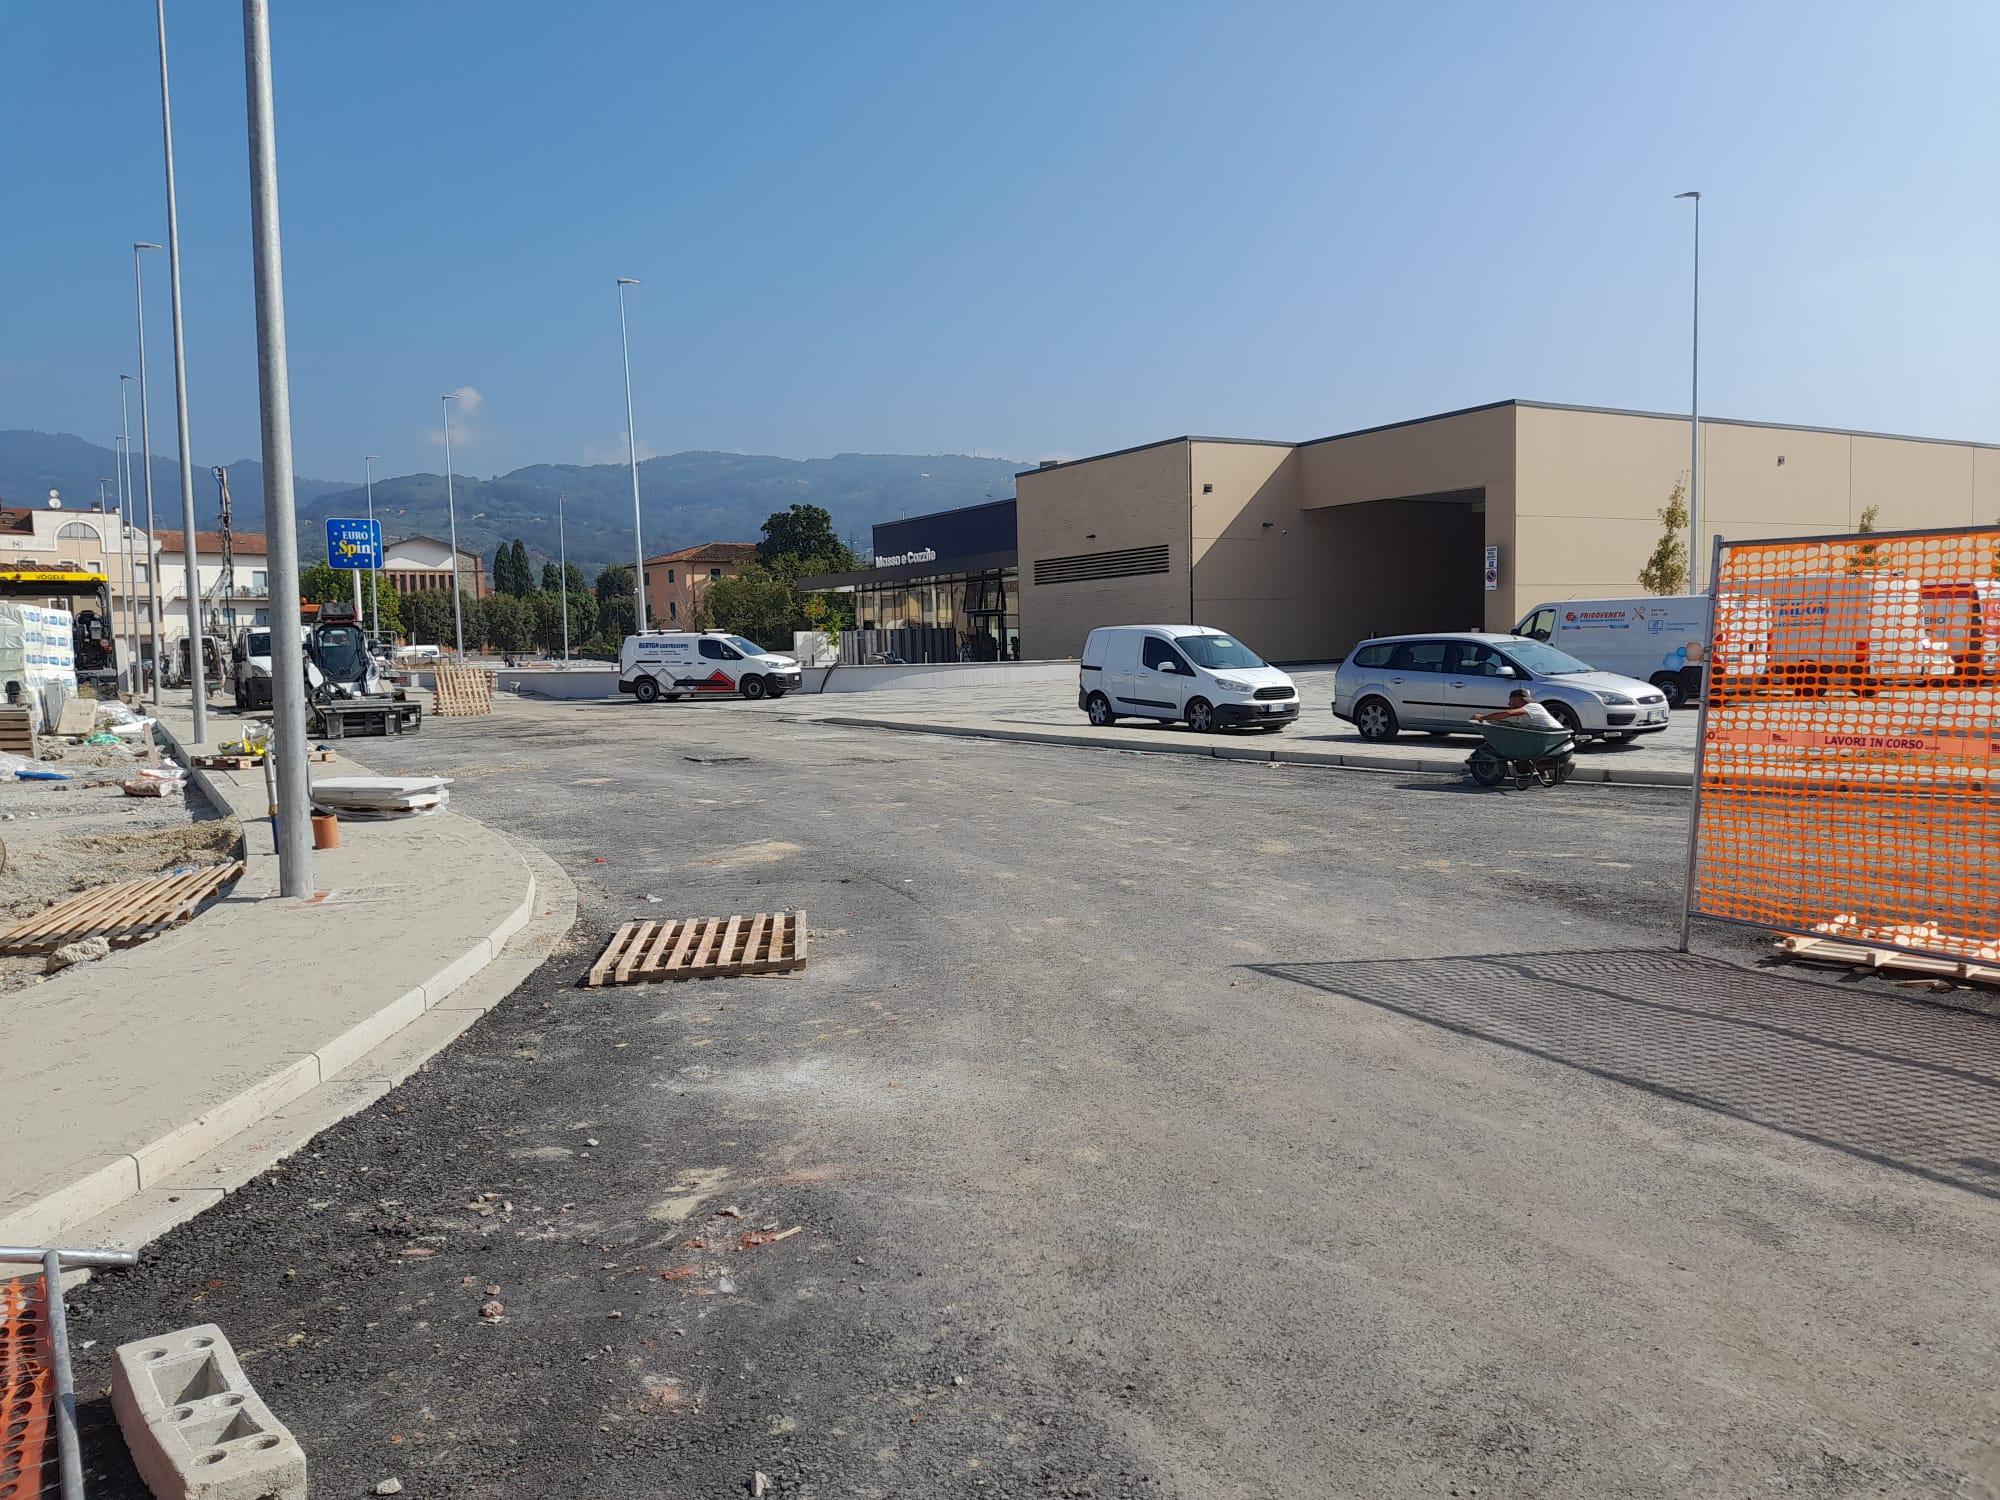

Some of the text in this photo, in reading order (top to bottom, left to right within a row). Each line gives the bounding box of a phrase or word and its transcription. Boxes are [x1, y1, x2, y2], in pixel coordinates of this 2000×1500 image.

[342, 531, 369, 540] EURO
[338, 540, 371, 558] Spin
[875, 547, 937, 569] Massa e Cozzile
[1580, 611, 1625, 619] FRIGOVENETA
[1824, 735, 1924, 749] LAVORI IN CORSO
